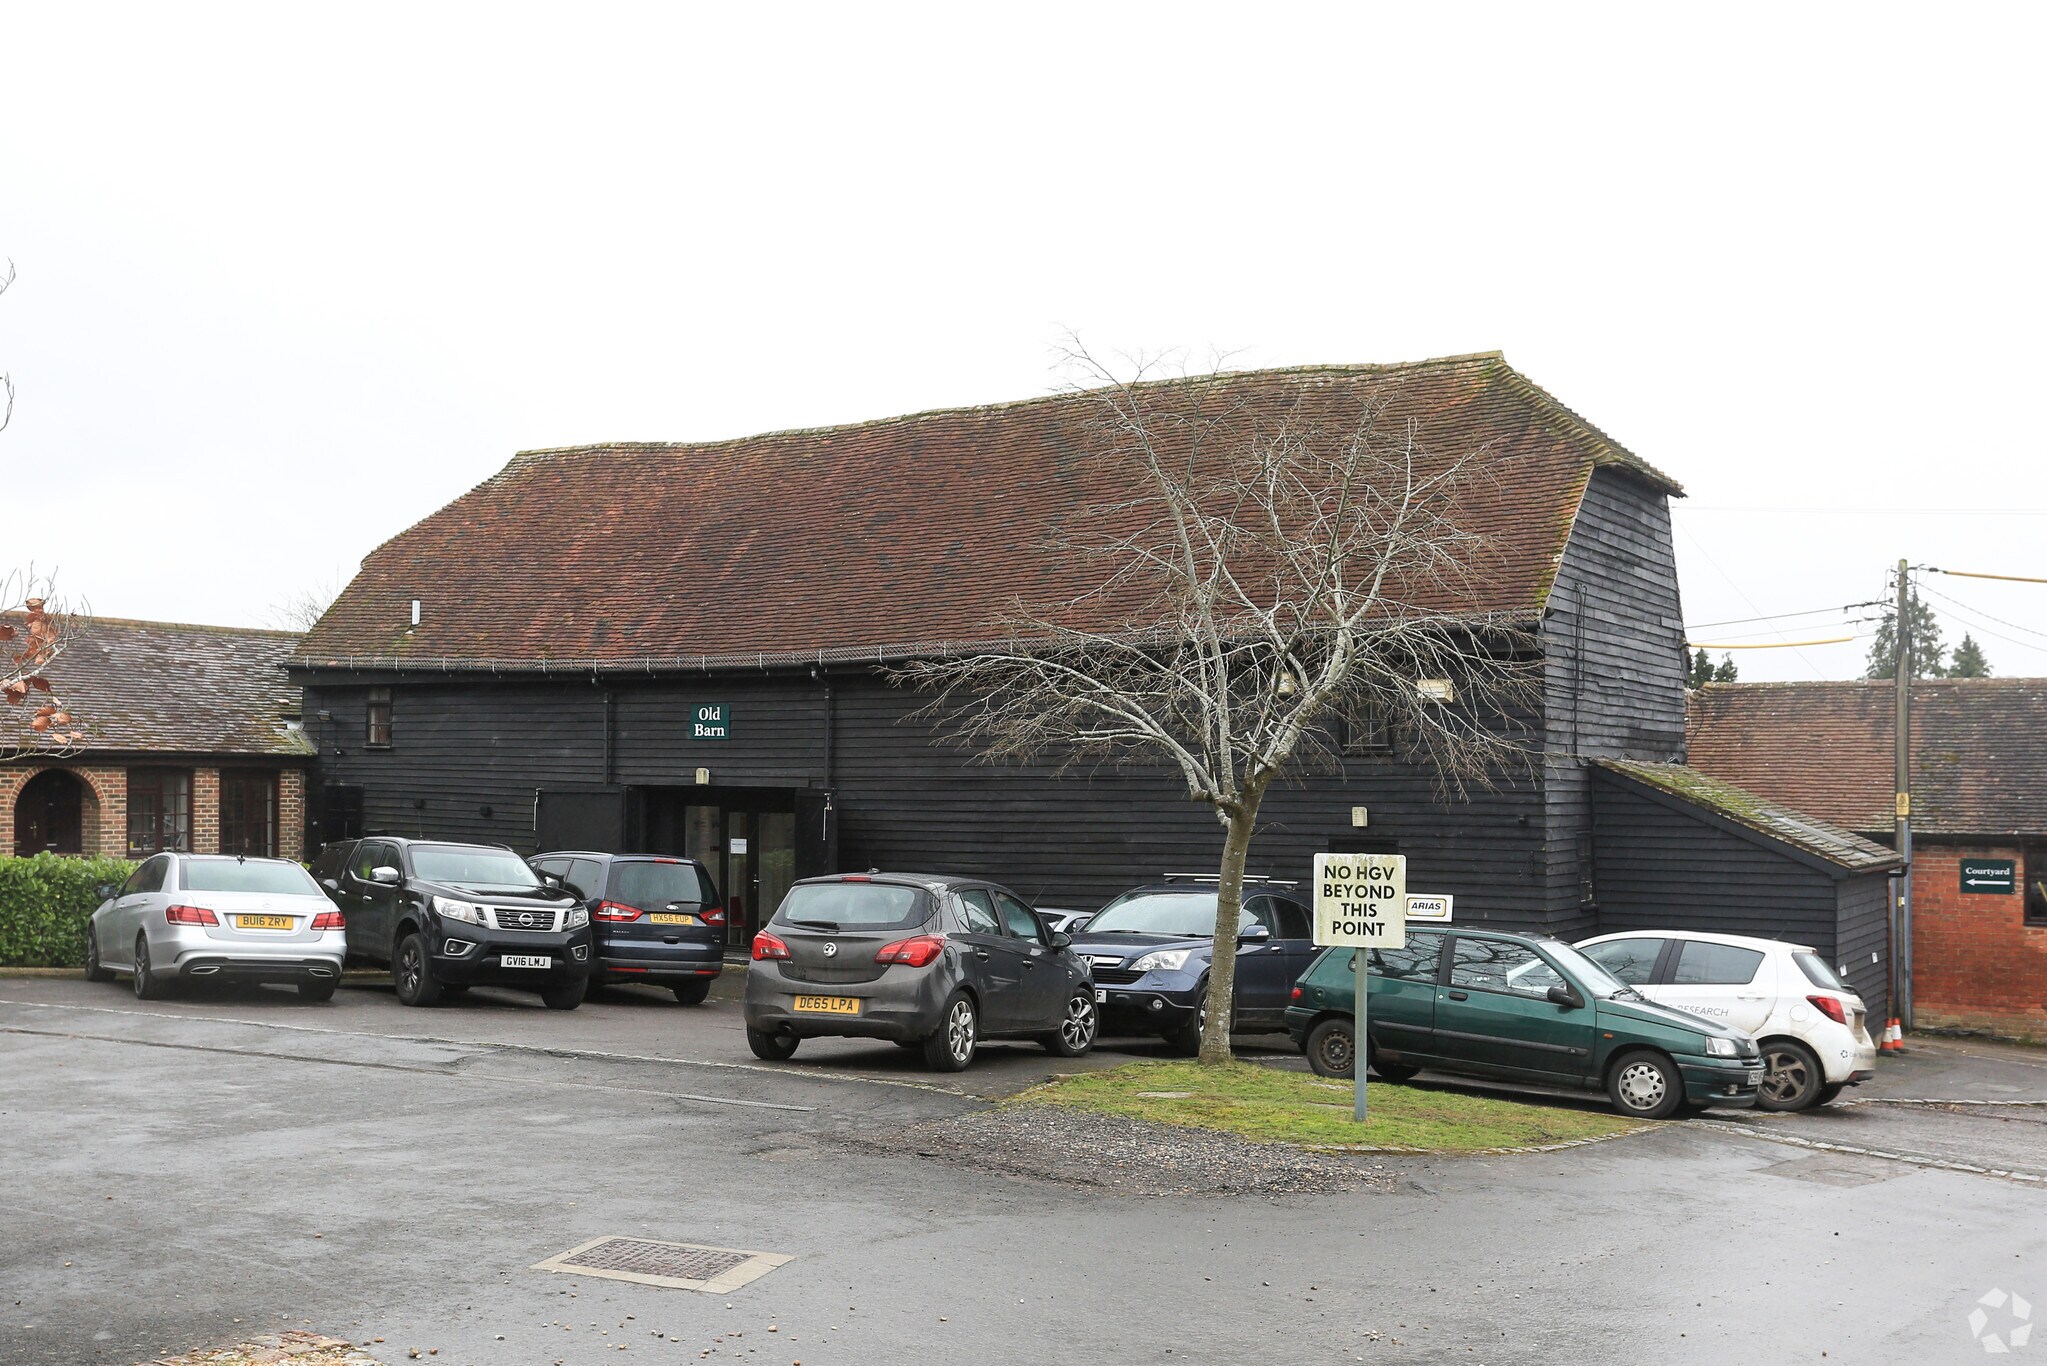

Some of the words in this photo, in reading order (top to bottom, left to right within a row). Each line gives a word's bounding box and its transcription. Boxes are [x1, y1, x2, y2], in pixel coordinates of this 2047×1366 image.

[698, 706, 721, 720] Old
[694, 723, 725, 736] Barn
[1324, 865, 1351, 880] NO
[1356, 866, 1395, 881] HGV
[1965, 866, 2010, 877] Courtyard
[1323, 884, 1395, 899] BEYOND
[1341, 903, 1377, 917] THIS
[1411, 902, 1442, 910] ARIAS
[243, 916, 265, 926] BU16
[268, 917, 287, 926] ZRY
[1332, 921, 1385, 936] POINT
[506, 956, 527, 967] GV16
[528, 957, 546, 967] LMJ
[831, 999, 853, 1011] LPA
